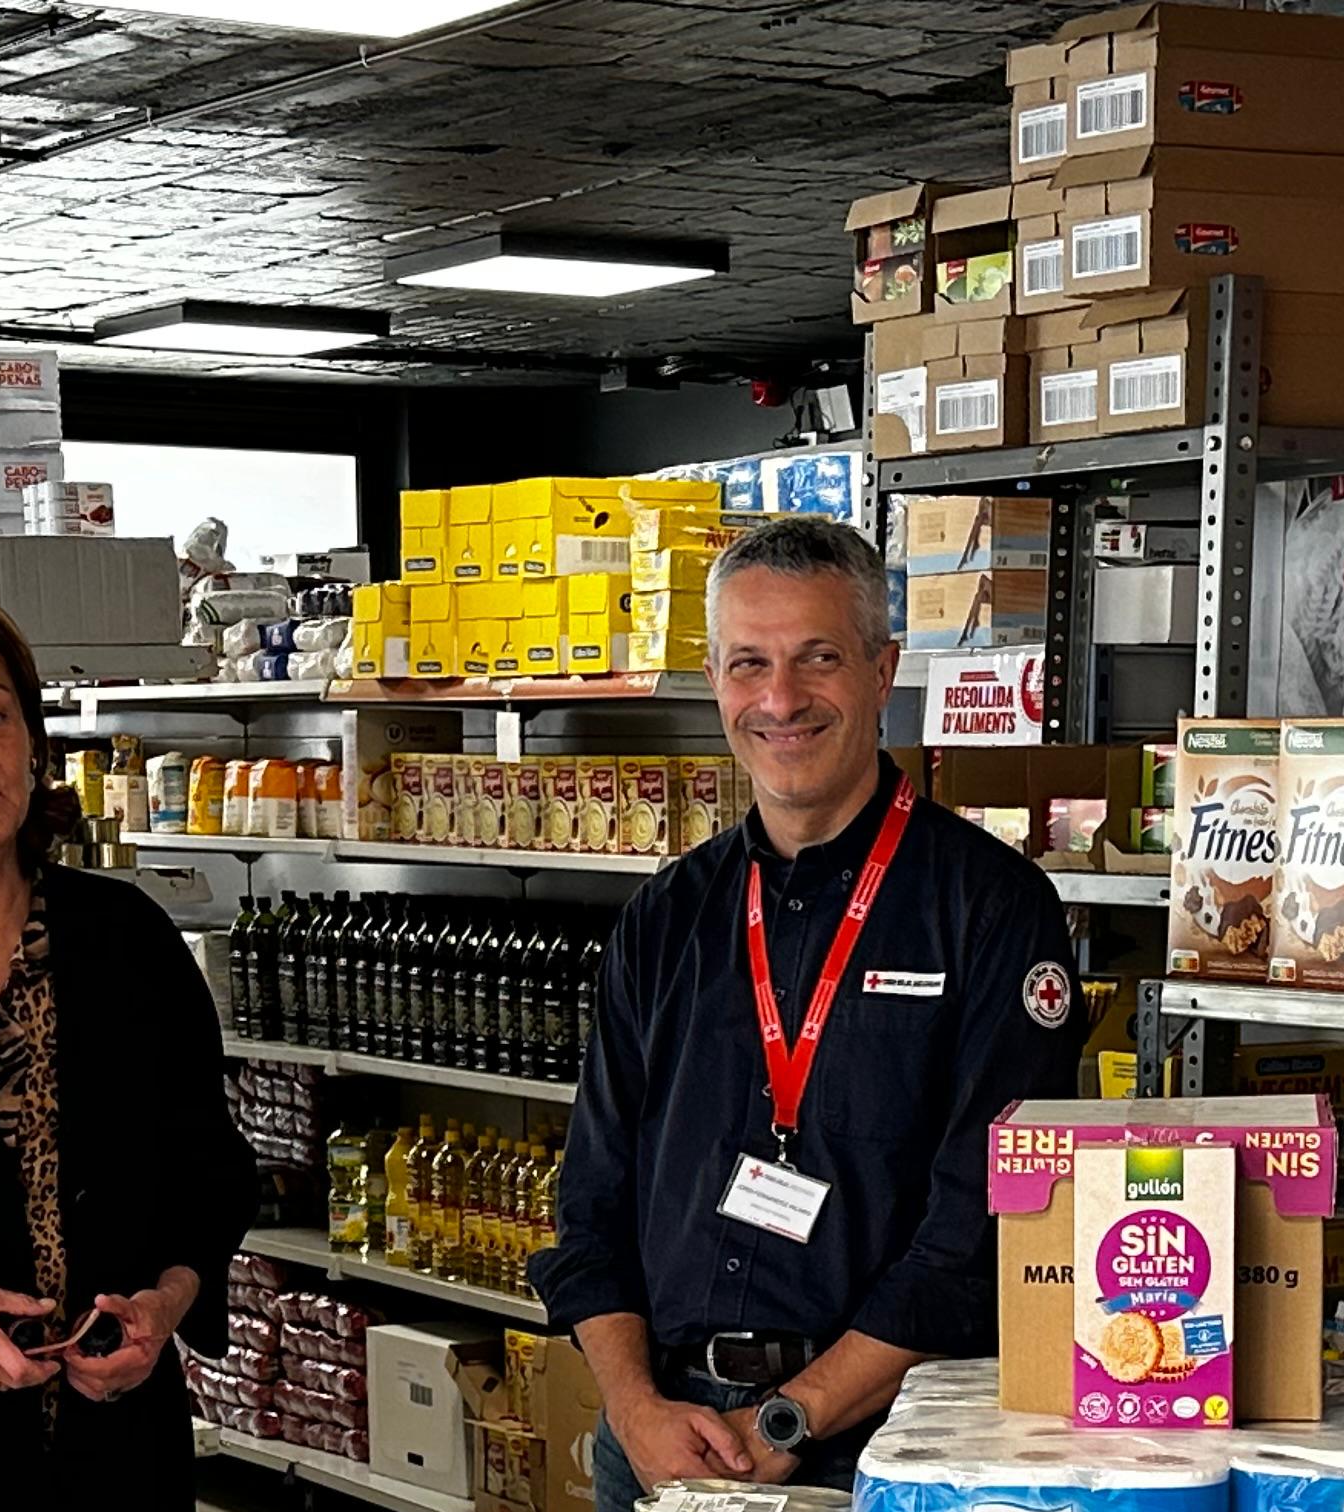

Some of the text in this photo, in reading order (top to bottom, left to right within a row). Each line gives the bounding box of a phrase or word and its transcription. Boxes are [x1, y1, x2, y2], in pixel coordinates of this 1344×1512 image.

[943, 686, 1014, 709] RECOLLIDA
[942, 712, 1017, 734] D'ALIMENTS
[1188, 803, 1276, 863] Fitnes
[998, 1129, 1073, 1154] FREE
[1127, 1179, 1181, 1199] gullón
[1023, 1265, 1075, 1284] MAR
